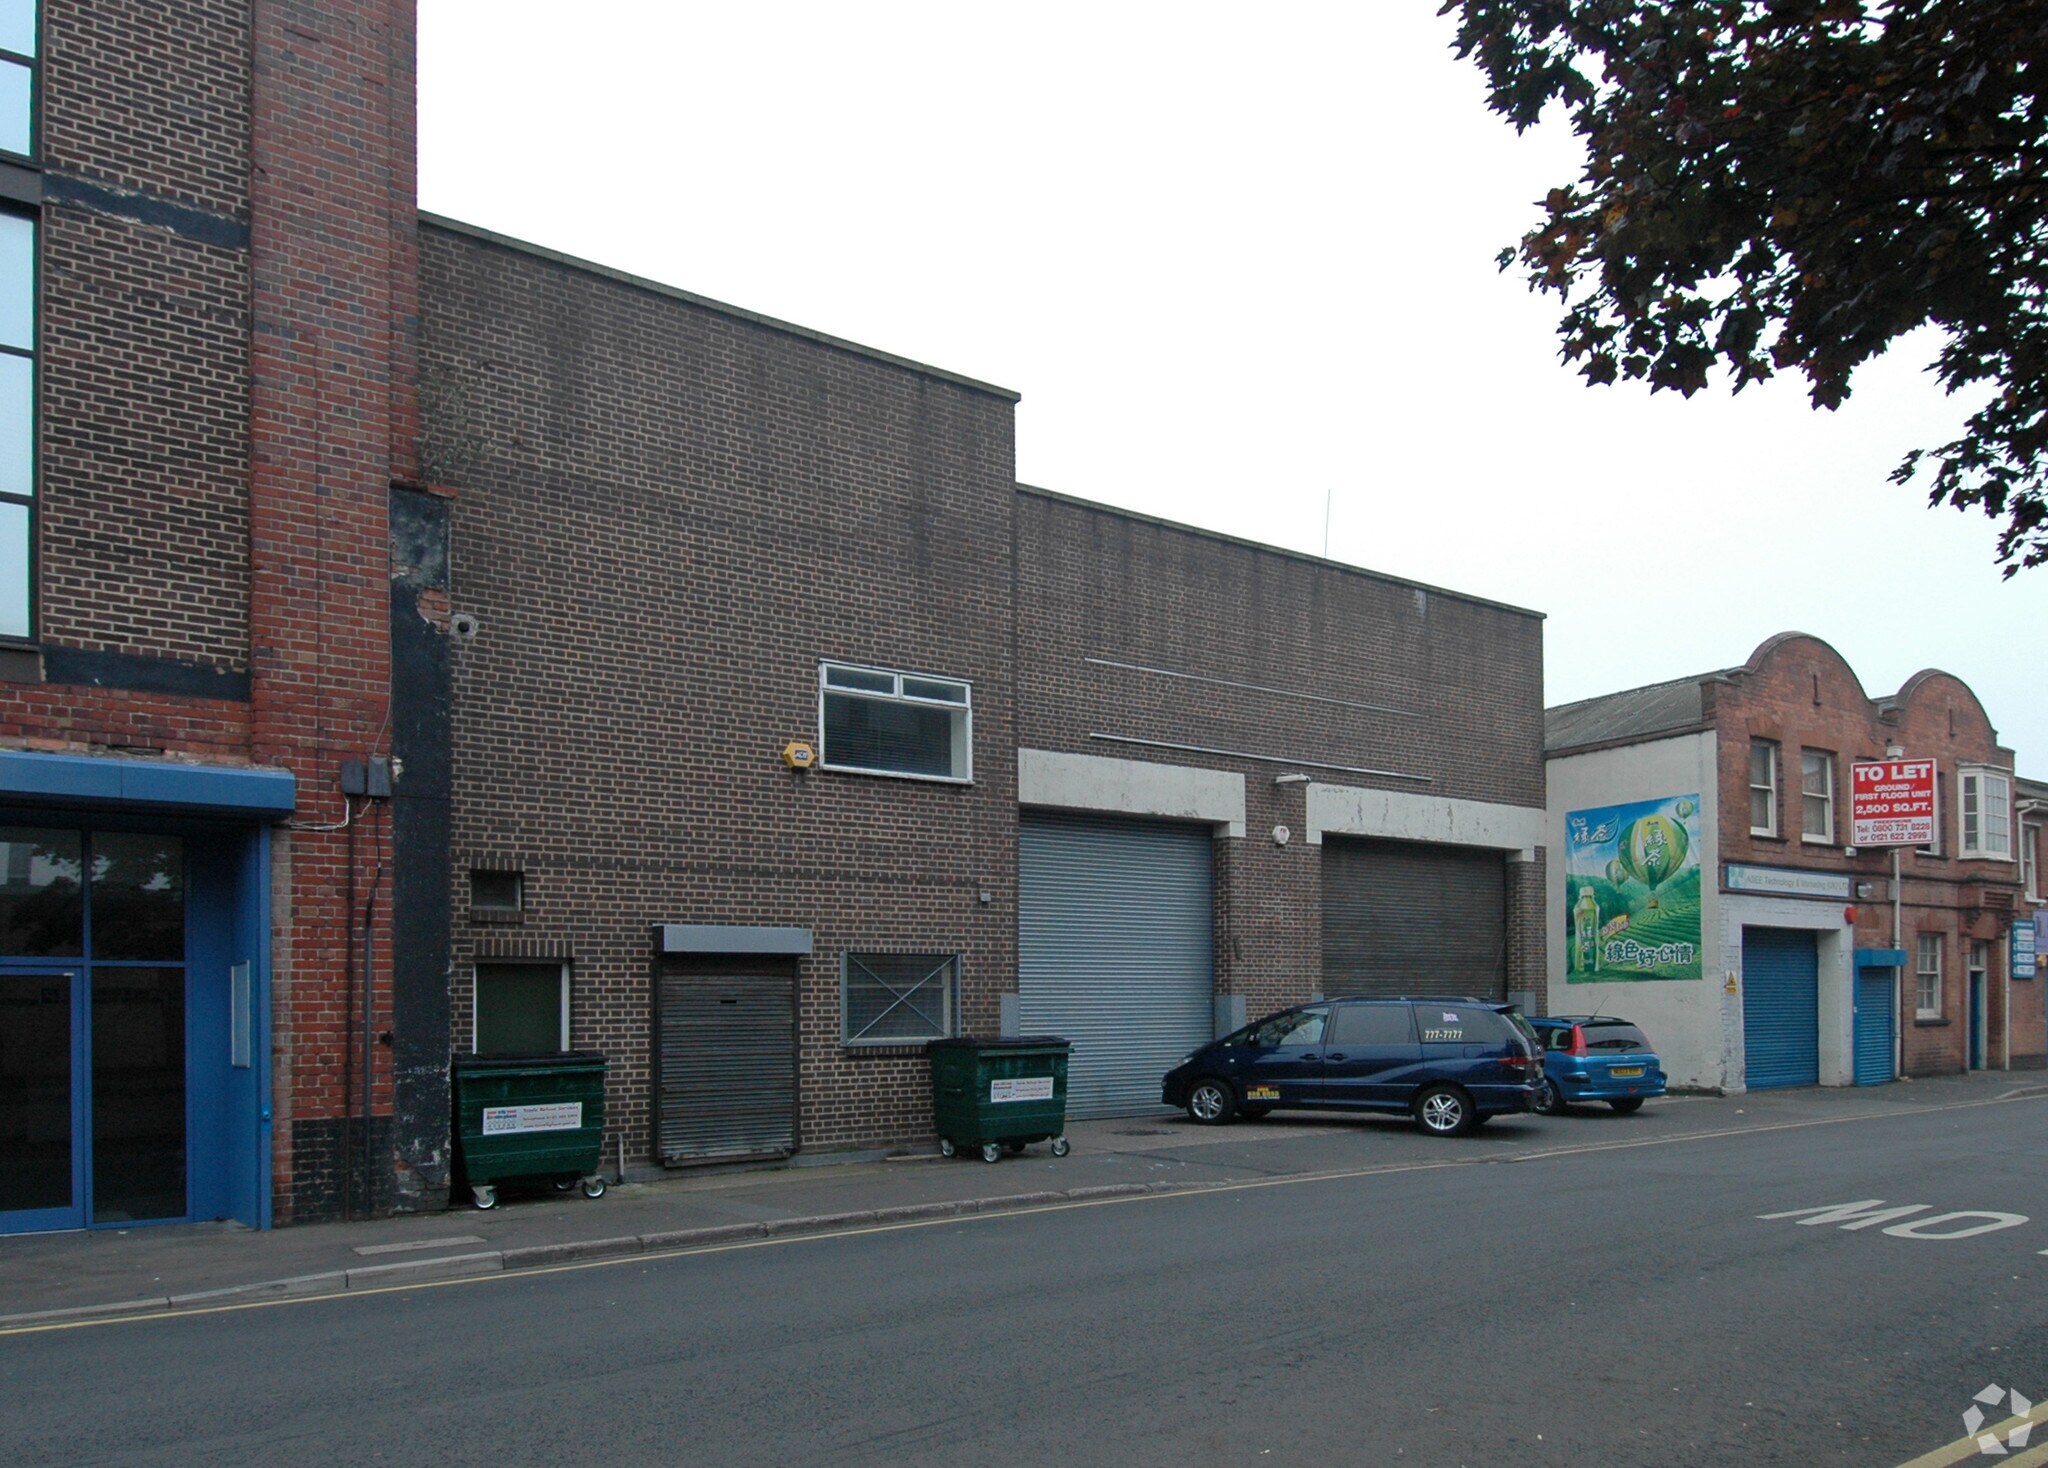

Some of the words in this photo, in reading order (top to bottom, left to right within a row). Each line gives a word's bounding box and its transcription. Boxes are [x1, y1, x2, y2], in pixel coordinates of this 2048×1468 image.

[1855, 766, 1884, 782] TO
[1891, 763, 1931, 780] LET
[1855, 793, 1879, 801] FIRST
[1881, 791, 1909, 800] FLOOR
[1911, 790, 1932, 798] UNIT
[1855, 804, 1889, 815] 2,500
[1893, 802, 1932, 813] SQ.FT.
[1856, 825, 1870, 833] Tel:
[1872, 824, 1893, 832] 0800
[1895, 823, 1908, 831] 731
[1870, 833, 1888, 841] 0121
[1890, 832, 1904, 840] 622
[1424, 1030, 1463, 1039] 777-7777
